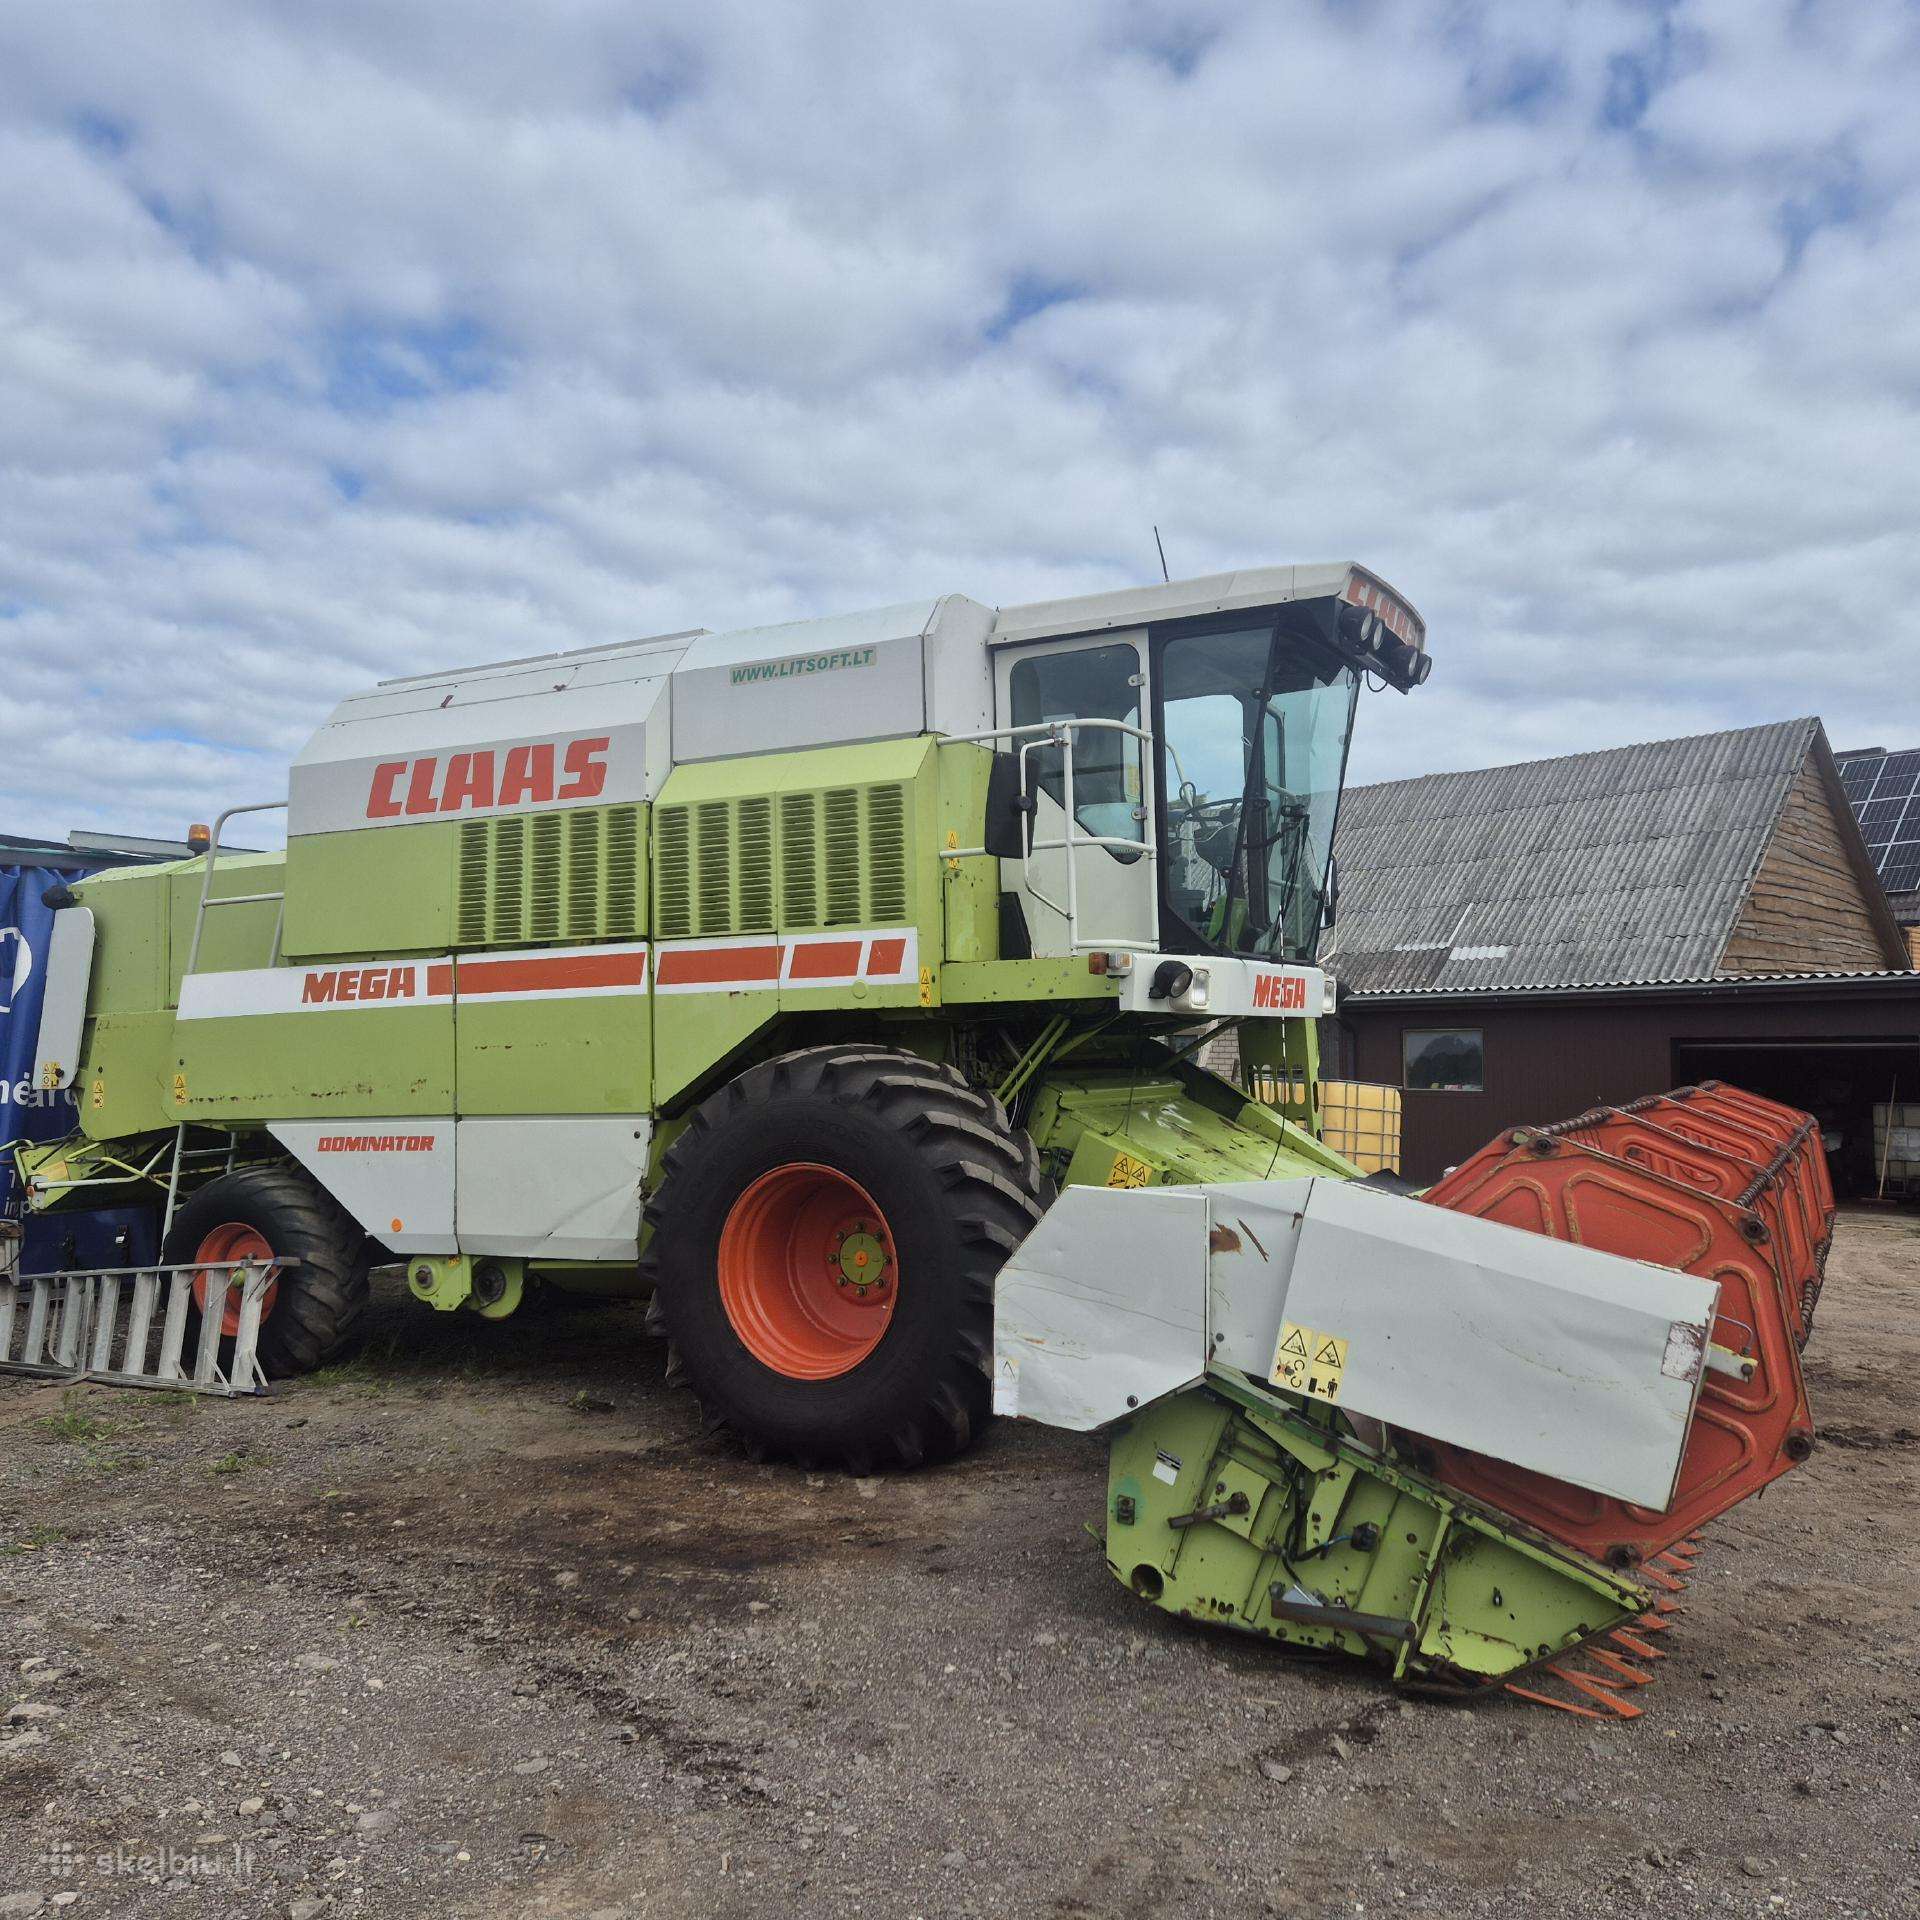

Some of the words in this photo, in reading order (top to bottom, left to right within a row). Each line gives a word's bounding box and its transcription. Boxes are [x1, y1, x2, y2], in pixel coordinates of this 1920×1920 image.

[732, 649, 874, 684] WWW.LITSOFT.LT
[366, 736, 610, 819] CLAAS
[301, 966, 416, 1004] MEGA
[1253, 974, 1306, 1009] MEGA
[317, 1135, 435, 1152] DOMINATOR
